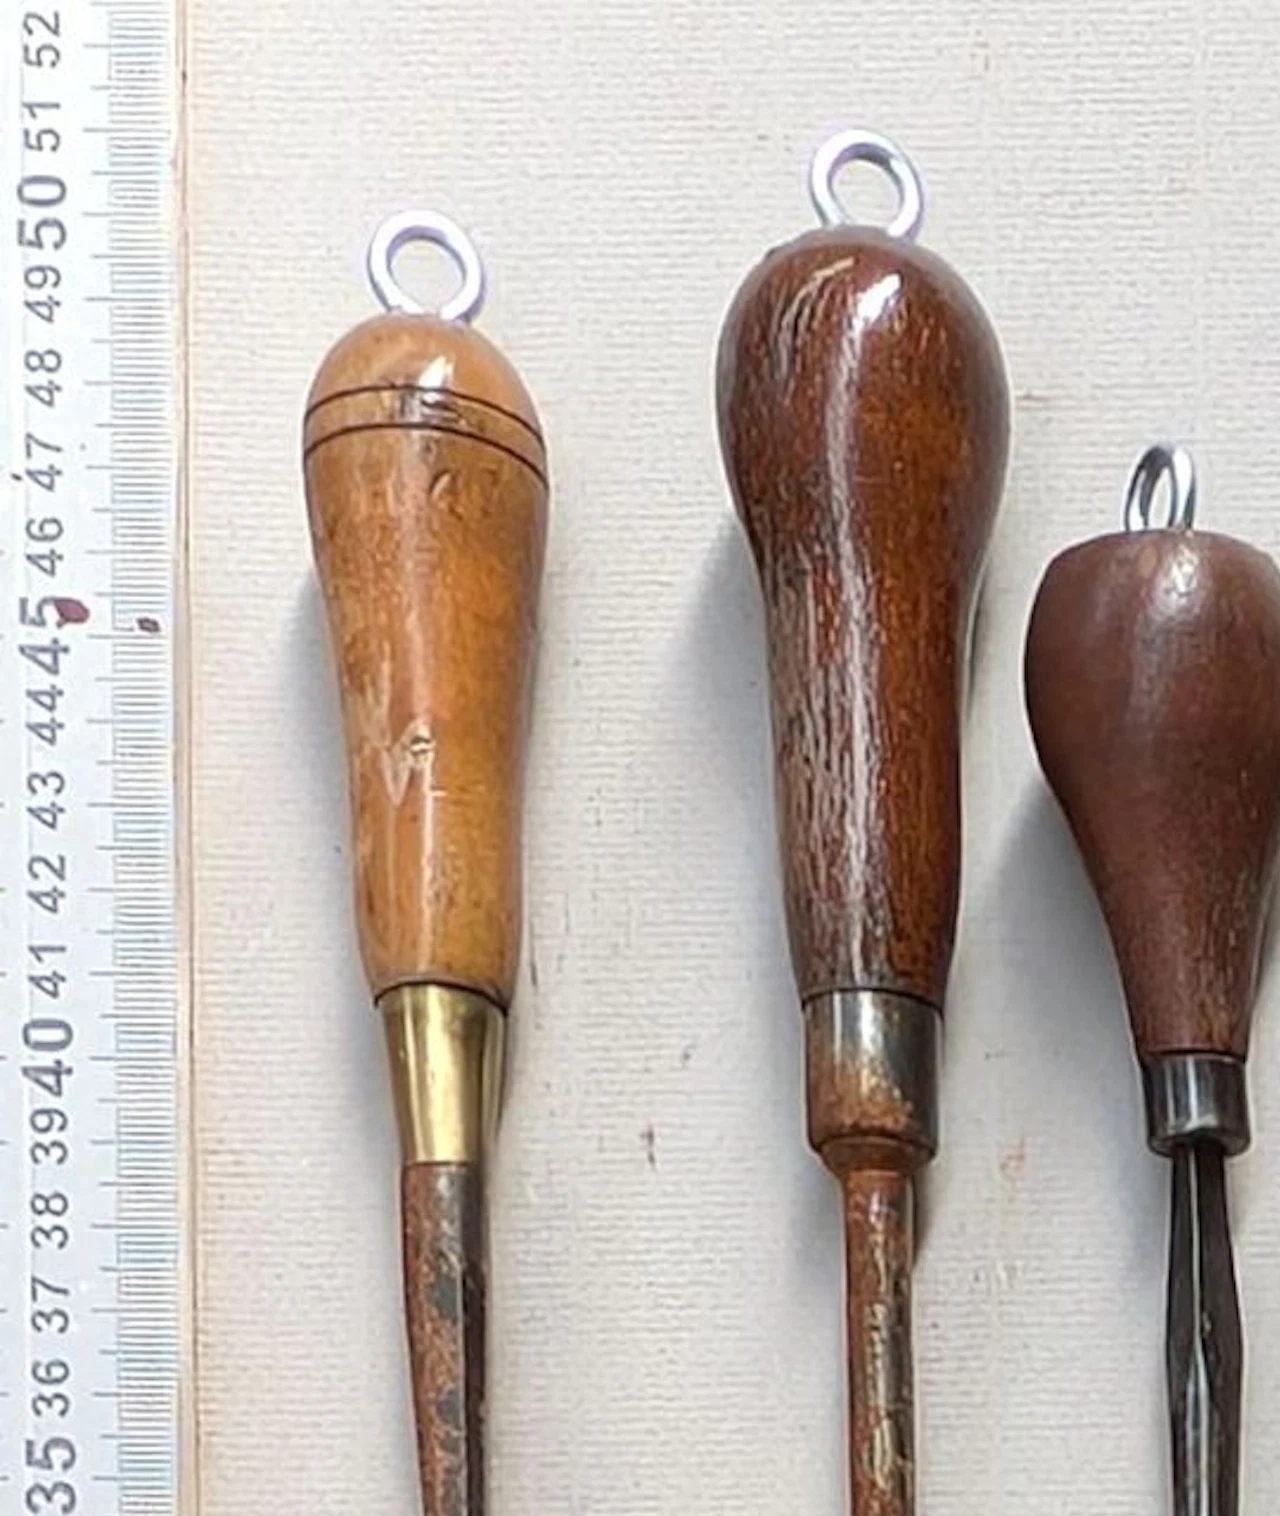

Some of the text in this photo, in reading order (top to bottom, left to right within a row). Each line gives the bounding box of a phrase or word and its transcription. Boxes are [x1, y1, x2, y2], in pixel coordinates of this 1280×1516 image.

[21, 10, 62, 69] 52
[21, 101, 62, 153] 51
[16, 174, 68, 252] 50
[22, 264, 62, 324] 49
[23, 348, 63, 409] 48
[24, 431, 64, 493] 47
[23, 516, 65, 578] 46
[17, 595, 72, 677] 45
[24, 683, 65, 747] 44
[25, 770, 66, 831] 43
[26, 854, 66, 915] 42
[27, 944, 67, 1000] 41
[20, 1018, 74, 1098] 40
[28, 1107, 69, 1166] 39
[29, 1190, 70, 1250] 38
[30, 1274, 70, 1335] 37
[30, 1359, 71, 1418] 36
[24, 1436, 77, 1516] 35
